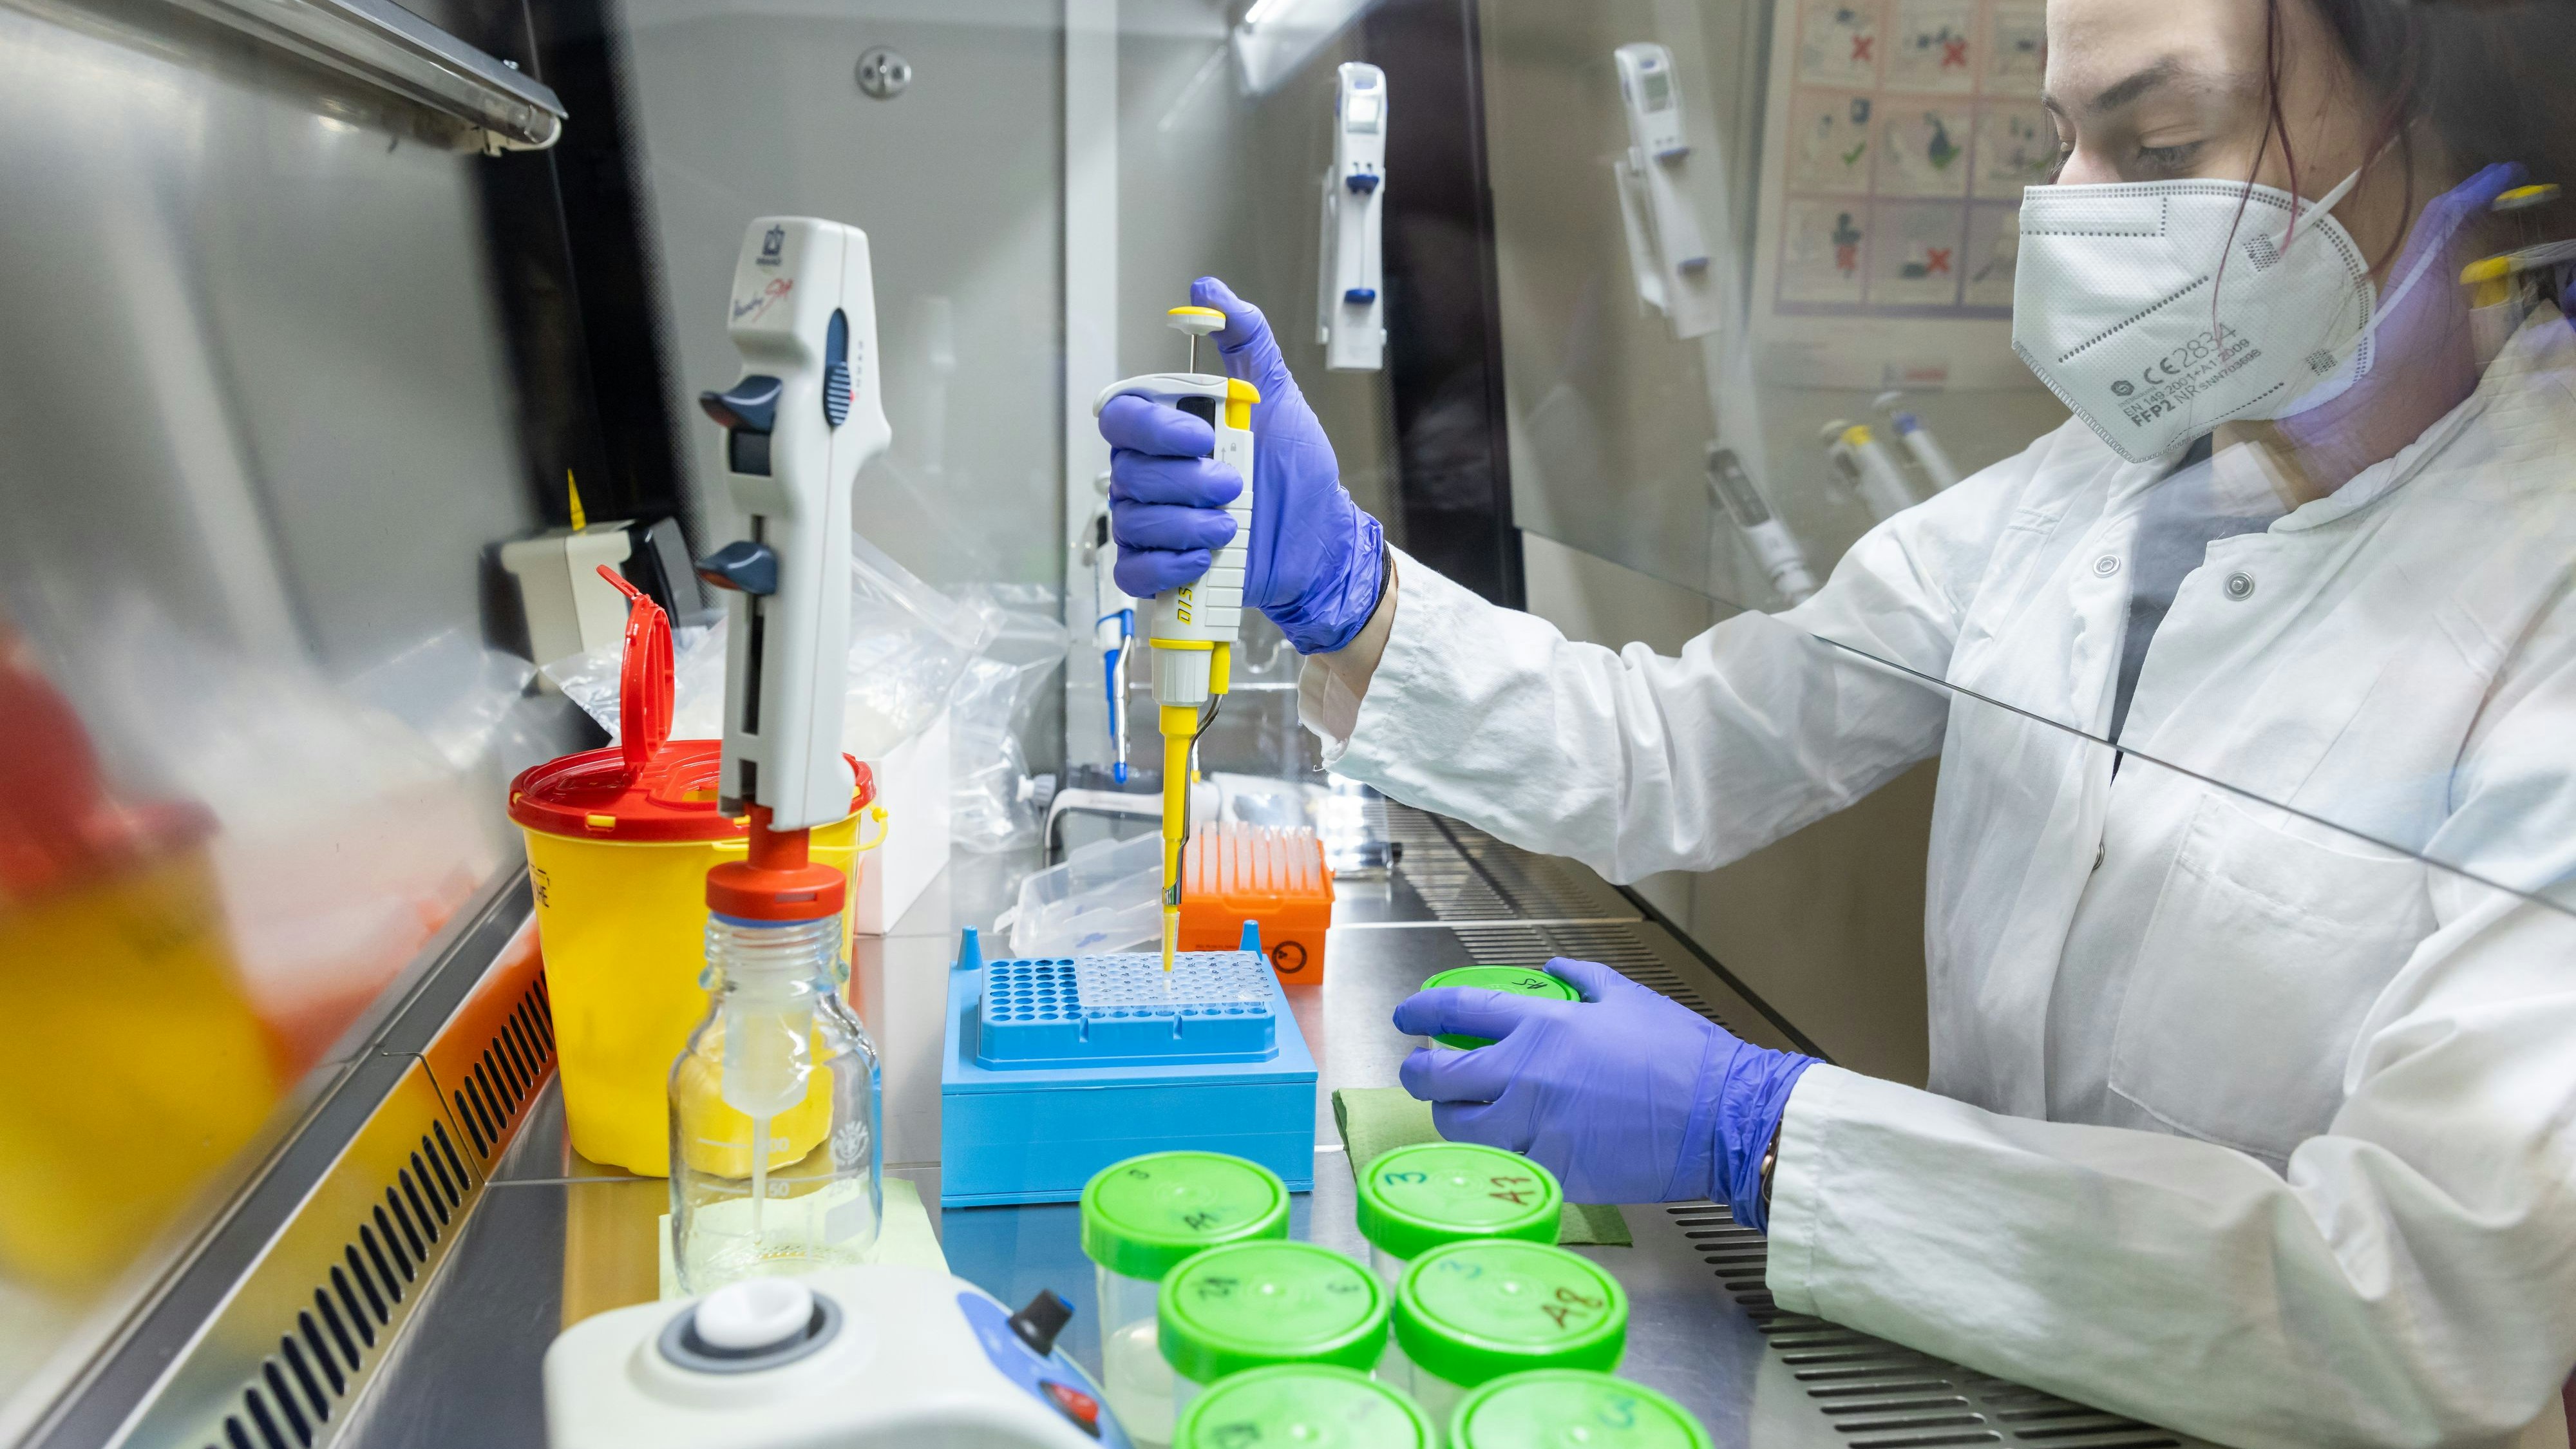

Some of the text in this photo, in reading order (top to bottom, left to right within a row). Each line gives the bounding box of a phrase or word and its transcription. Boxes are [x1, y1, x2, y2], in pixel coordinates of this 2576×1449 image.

[2123, 402, 2143, 417] EN
[2132, 399, 2176, 427] FFP2
[2174, 385, 2201, 404] NR
[1177, 583, 1195, 626] DIS
